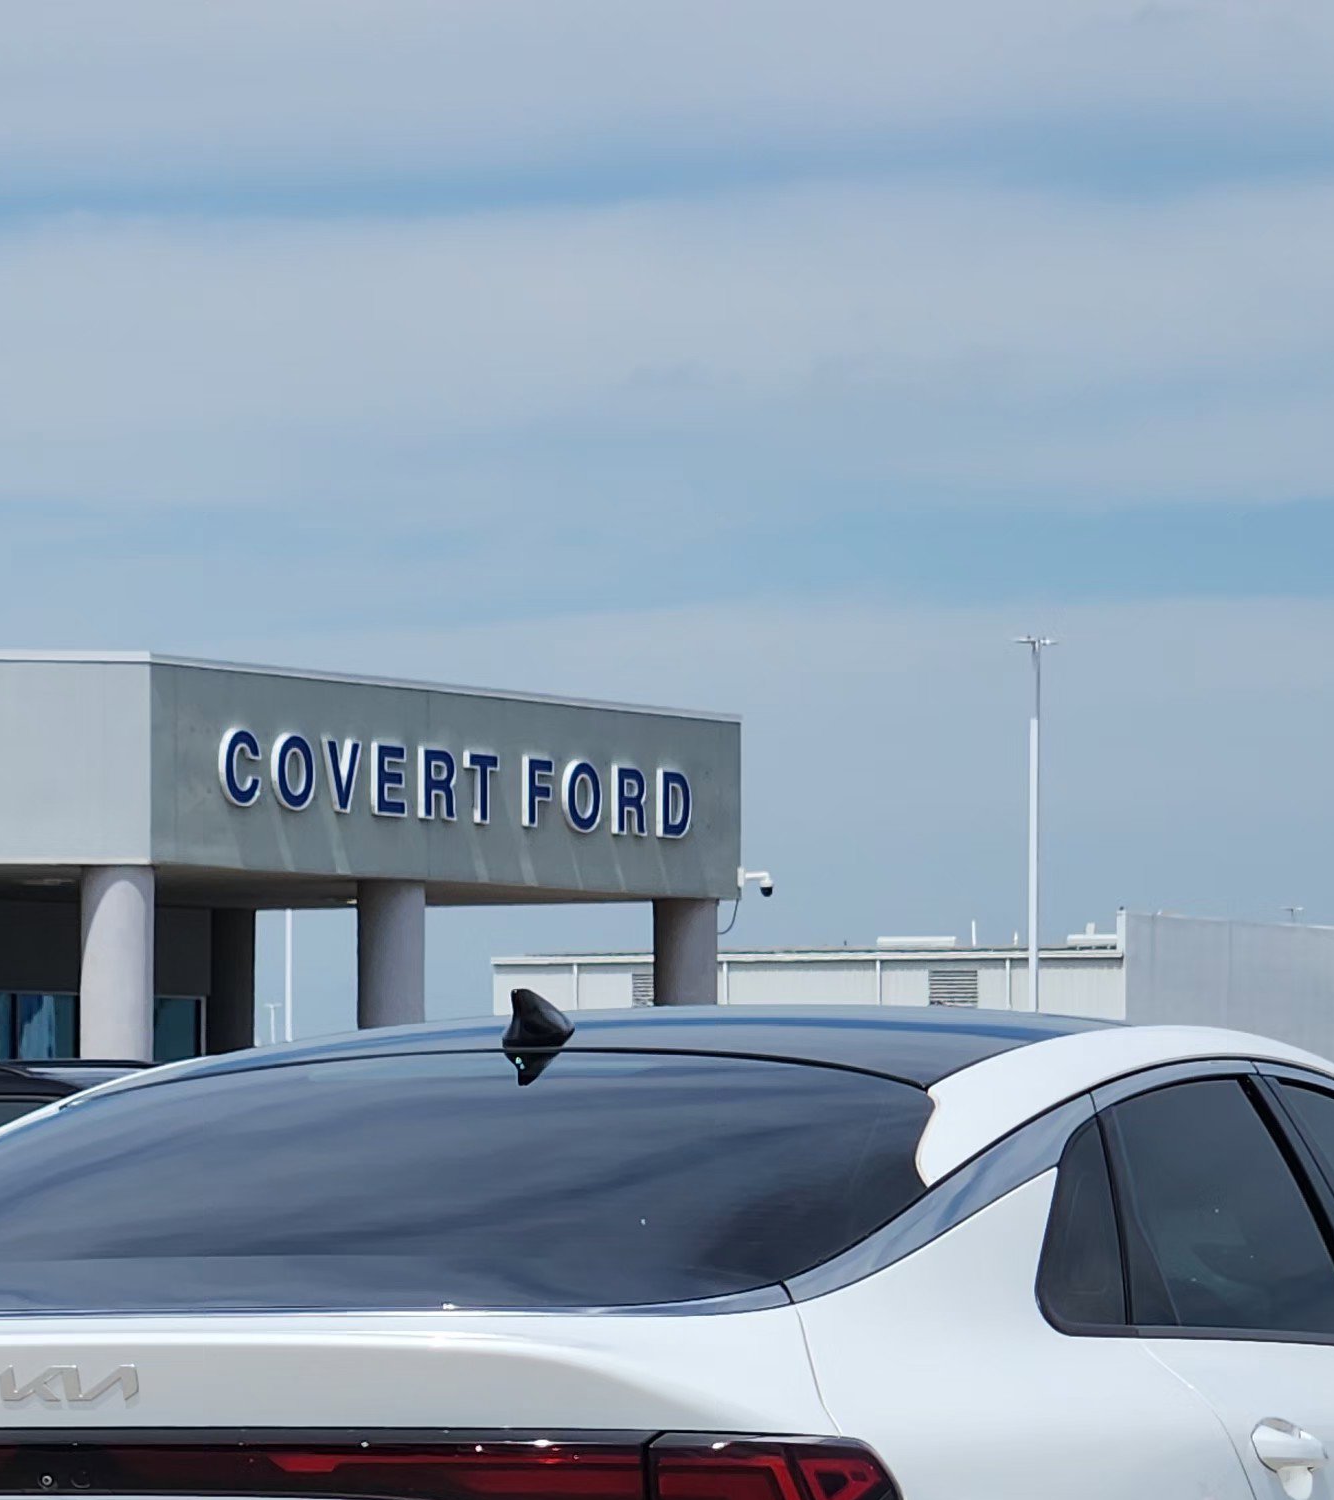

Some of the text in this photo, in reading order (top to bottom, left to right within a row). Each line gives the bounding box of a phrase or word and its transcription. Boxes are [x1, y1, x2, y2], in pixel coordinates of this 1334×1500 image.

[218, 727, 692, 839] COVERT FORD
[0, 1364, 139, 1402] KIA
